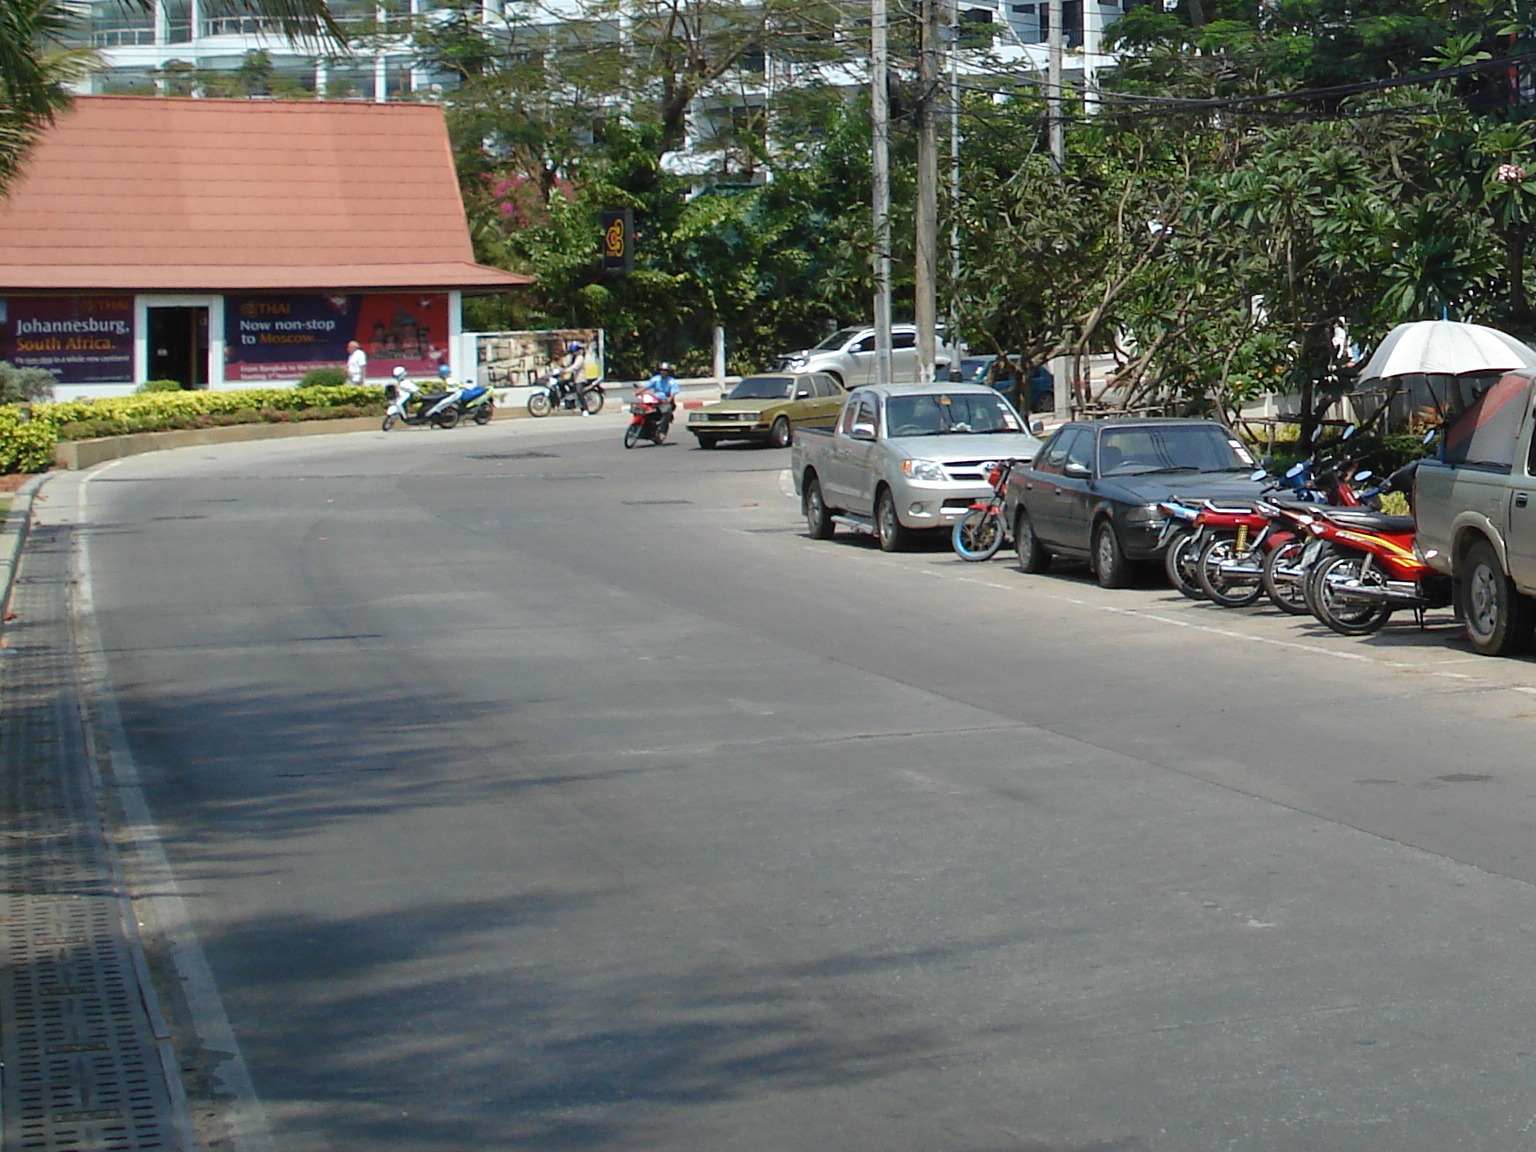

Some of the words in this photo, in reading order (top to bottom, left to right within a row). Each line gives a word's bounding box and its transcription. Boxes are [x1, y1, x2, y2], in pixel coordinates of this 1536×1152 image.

[260, 303, 290, 314] THAI
[240, 320, 271, 331] Now
[275, 319, 336, 331] non-stop
[16, 336, 60, 351] South
[65, 335, 116, 350] Africa.
[241, 333, 256, 345] to
